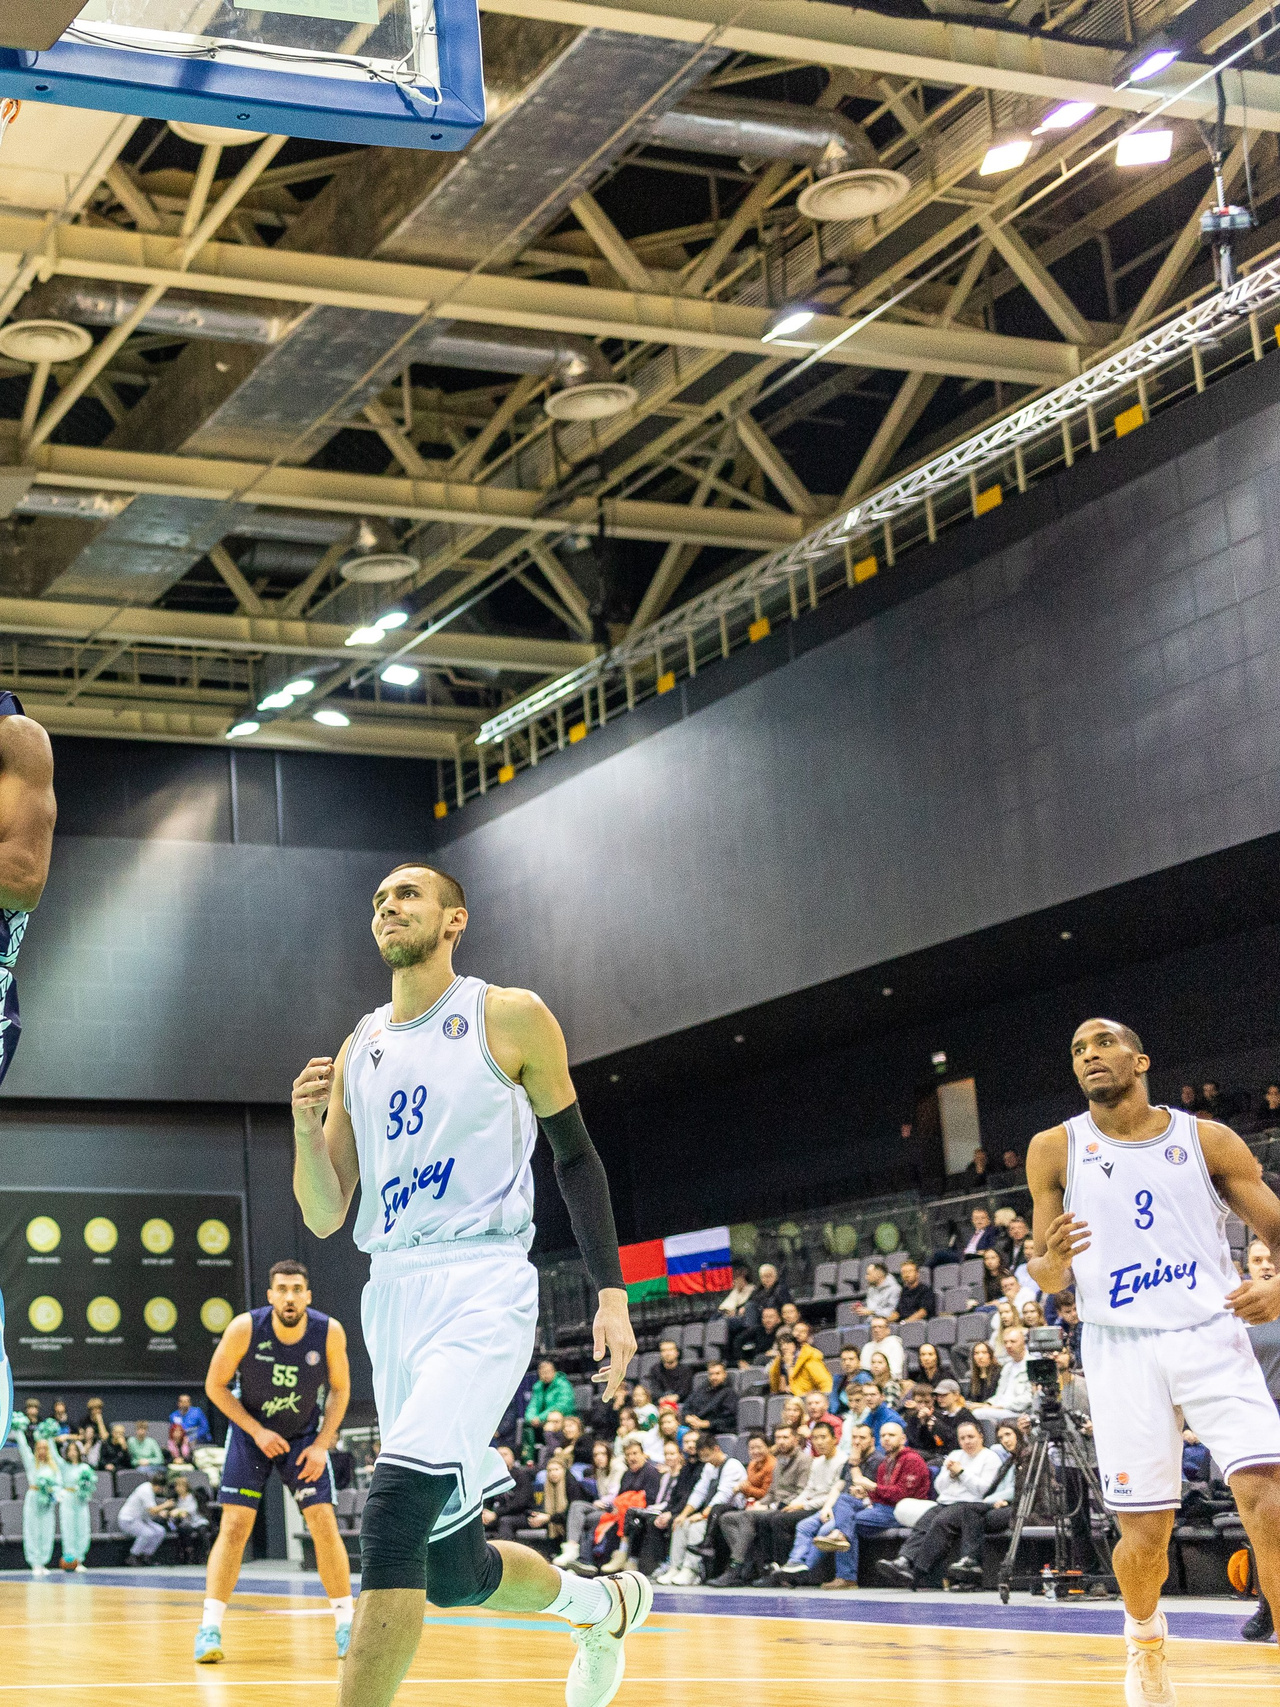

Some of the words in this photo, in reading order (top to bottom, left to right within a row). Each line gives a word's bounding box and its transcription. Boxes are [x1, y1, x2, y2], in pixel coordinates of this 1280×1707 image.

[386, 1084, 428, 1141] 33
[381, 1157, 456, 1235] Eniey
[1134, 1189, 1155, 1231] 3
[1109, 1257, 1198, 1309] Enisey
[271, 1363, 299, 1388] 55
